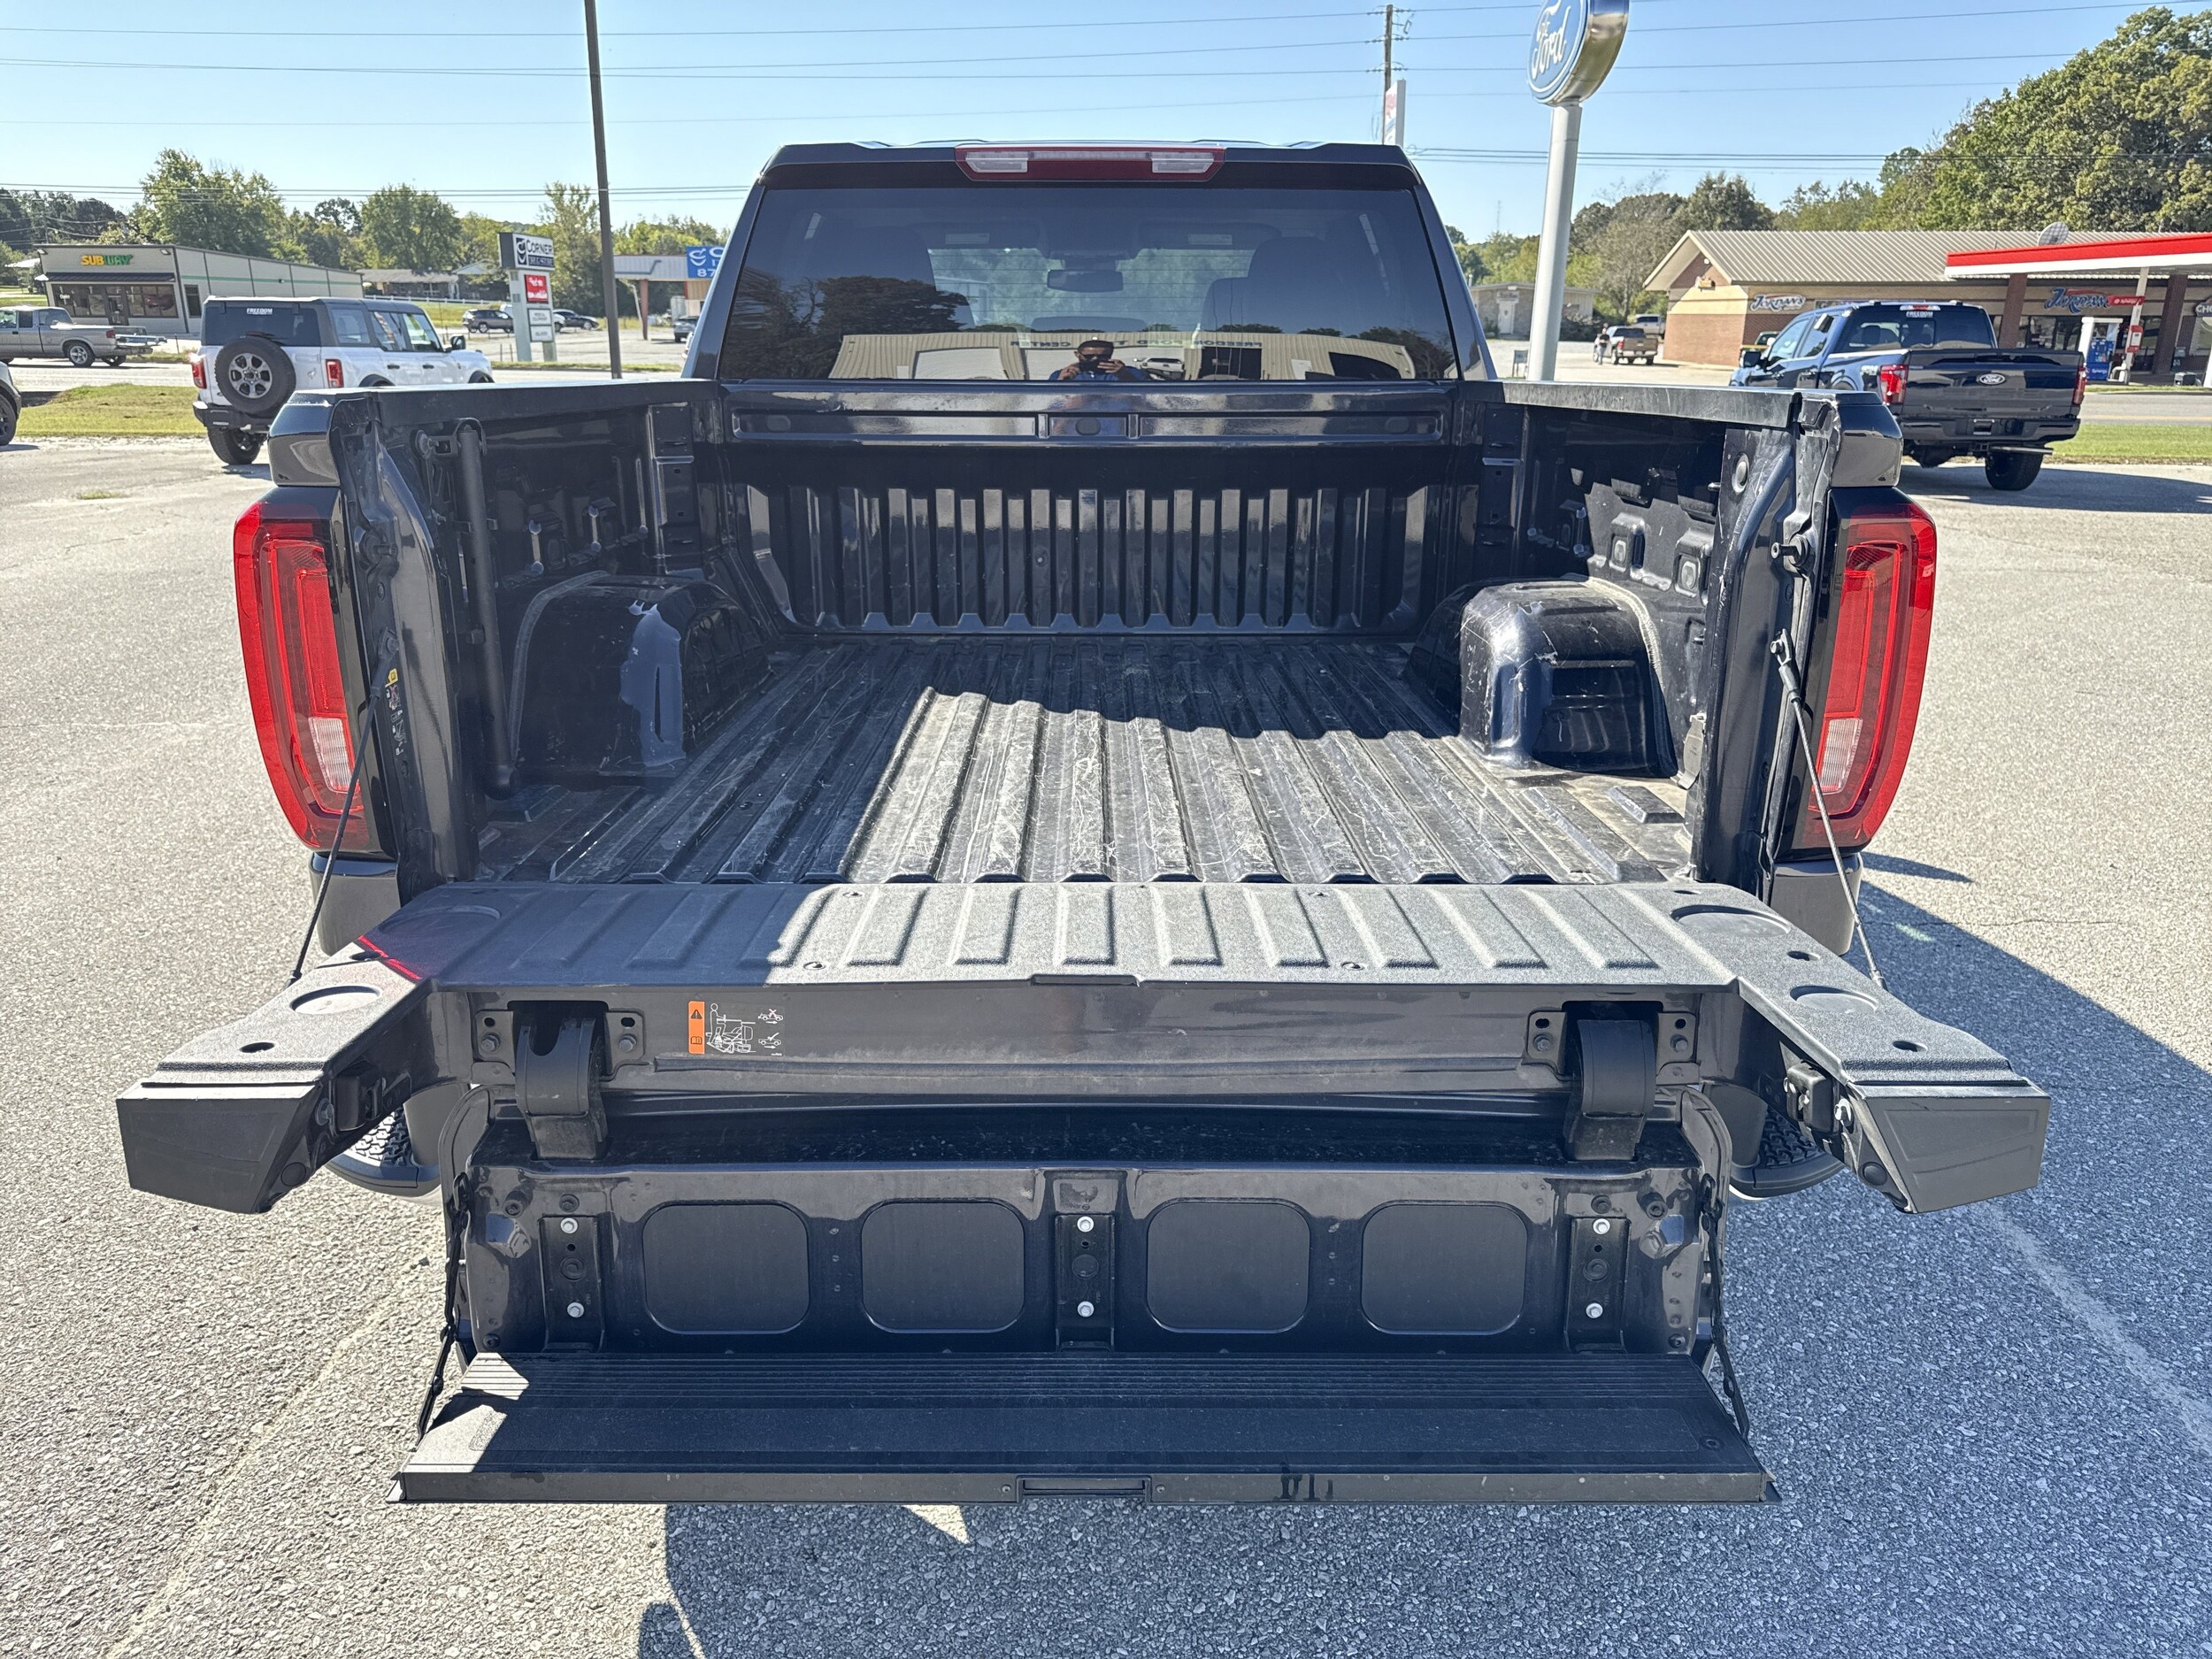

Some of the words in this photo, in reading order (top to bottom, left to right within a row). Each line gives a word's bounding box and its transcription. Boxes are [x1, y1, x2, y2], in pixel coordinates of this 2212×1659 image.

[1532, 0, 1571, 80] Ford
[526, 239, 553, 255] CORNER
[81, 254, 133, 265] SUBWAY
